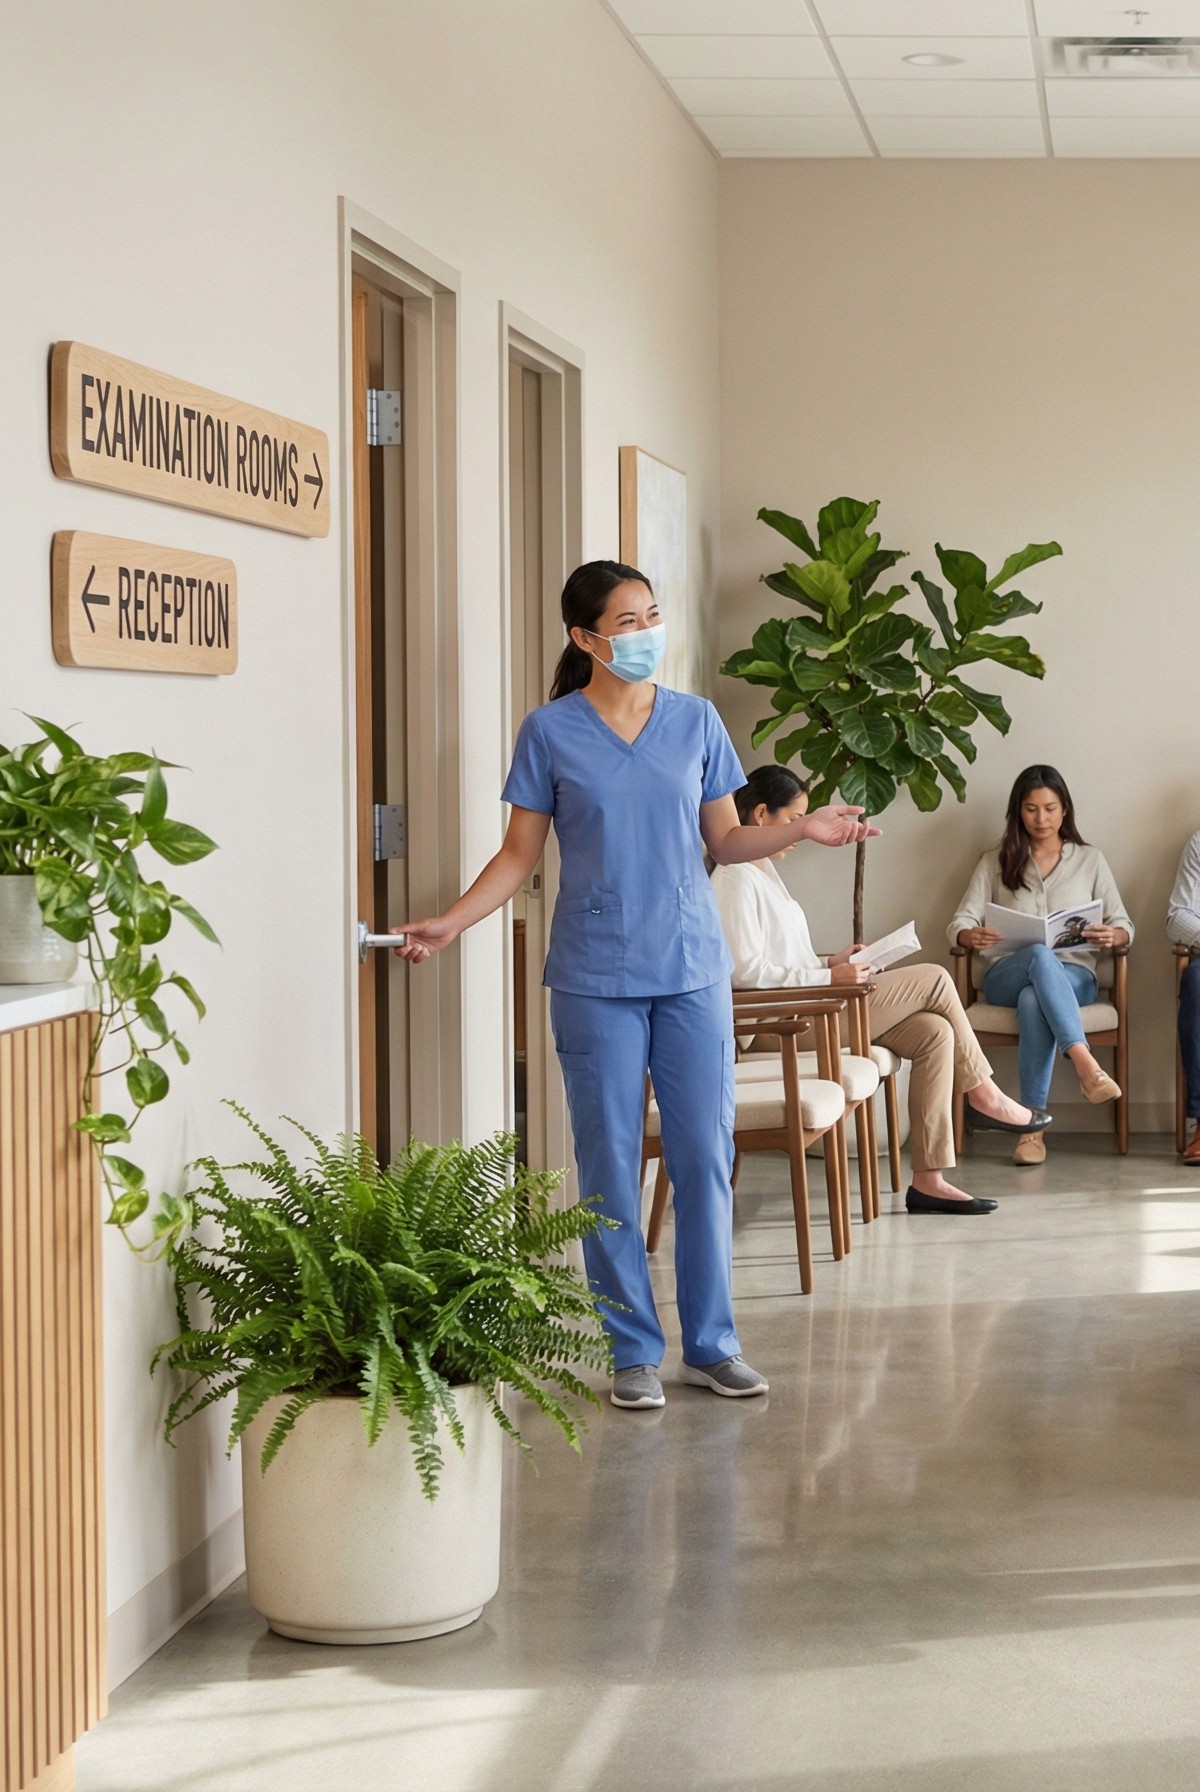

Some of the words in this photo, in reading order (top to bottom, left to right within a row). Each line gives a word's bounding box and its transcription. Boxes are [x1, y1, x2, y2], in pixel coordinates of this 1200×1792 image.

[81, 373, 229, 489] EXAMINATION
[236, 425, 298, 507] ROOMS
[118, 566, 229, 649] RECEPTION
